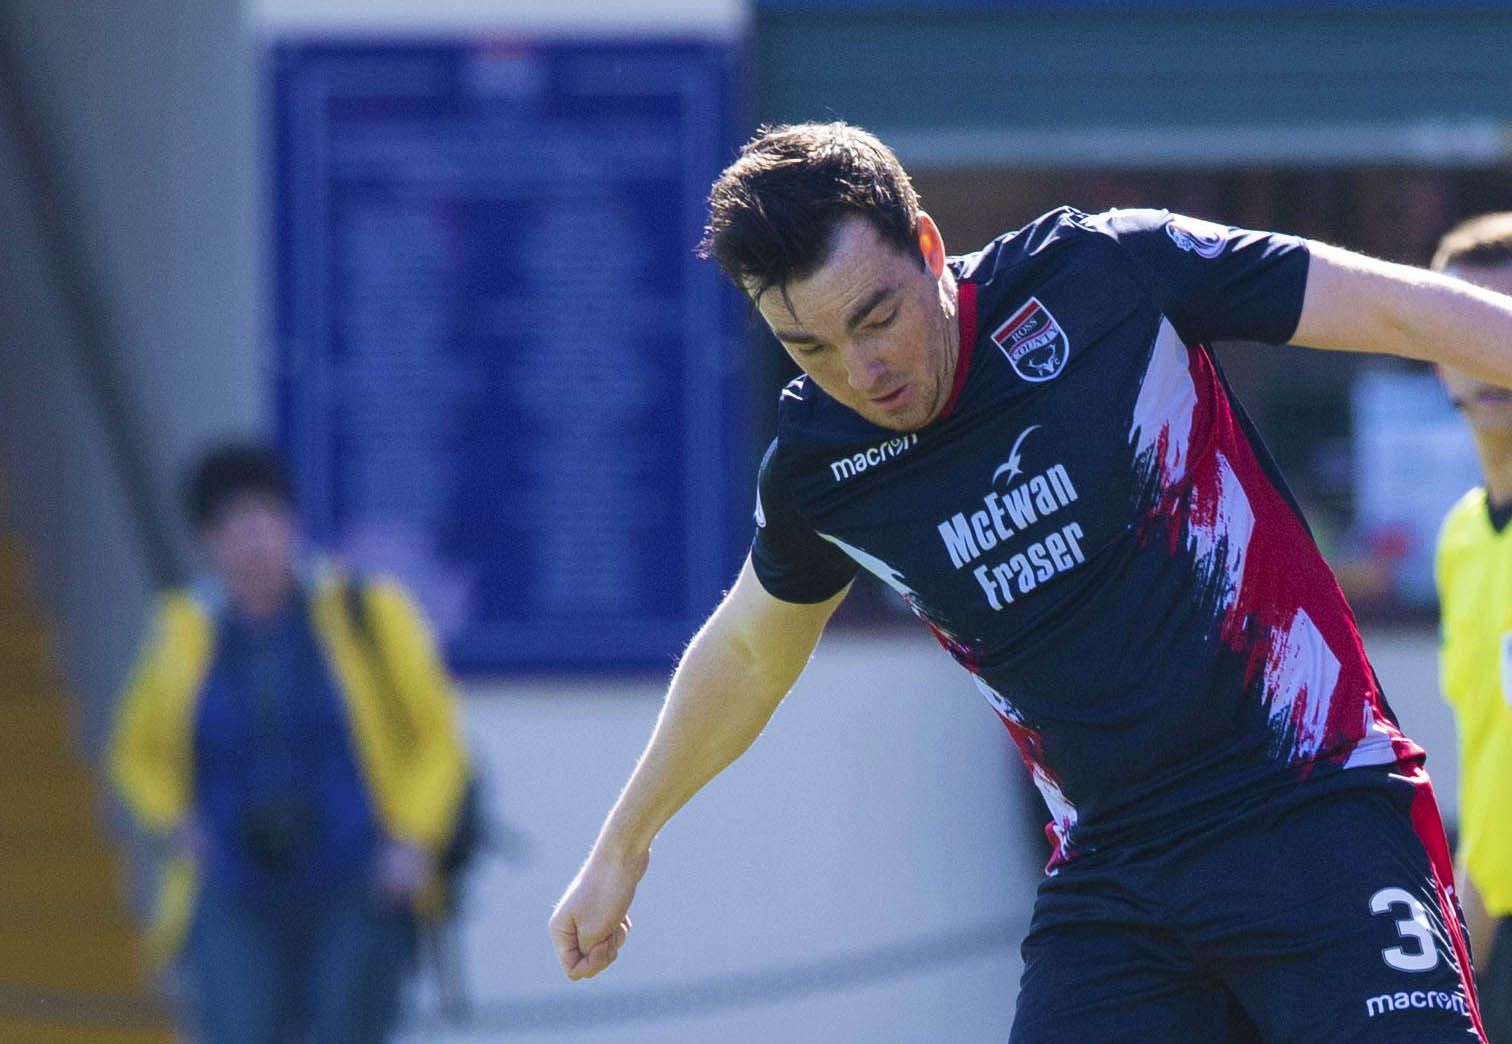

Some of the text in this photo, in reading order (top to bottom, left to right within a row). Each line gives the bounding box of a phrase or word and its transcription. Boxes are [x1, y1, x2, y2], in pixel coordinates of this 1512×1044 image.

[1011, 317, 1037, 343] ROSS
[829, 433, 918, 482] macron
[936, 463, 1079, 569] McEwan
[973, 521, 1086, 611] Fraser
[1368, 886, 1440, 973] 3
[1365, 990, 1470, 1018] macron
